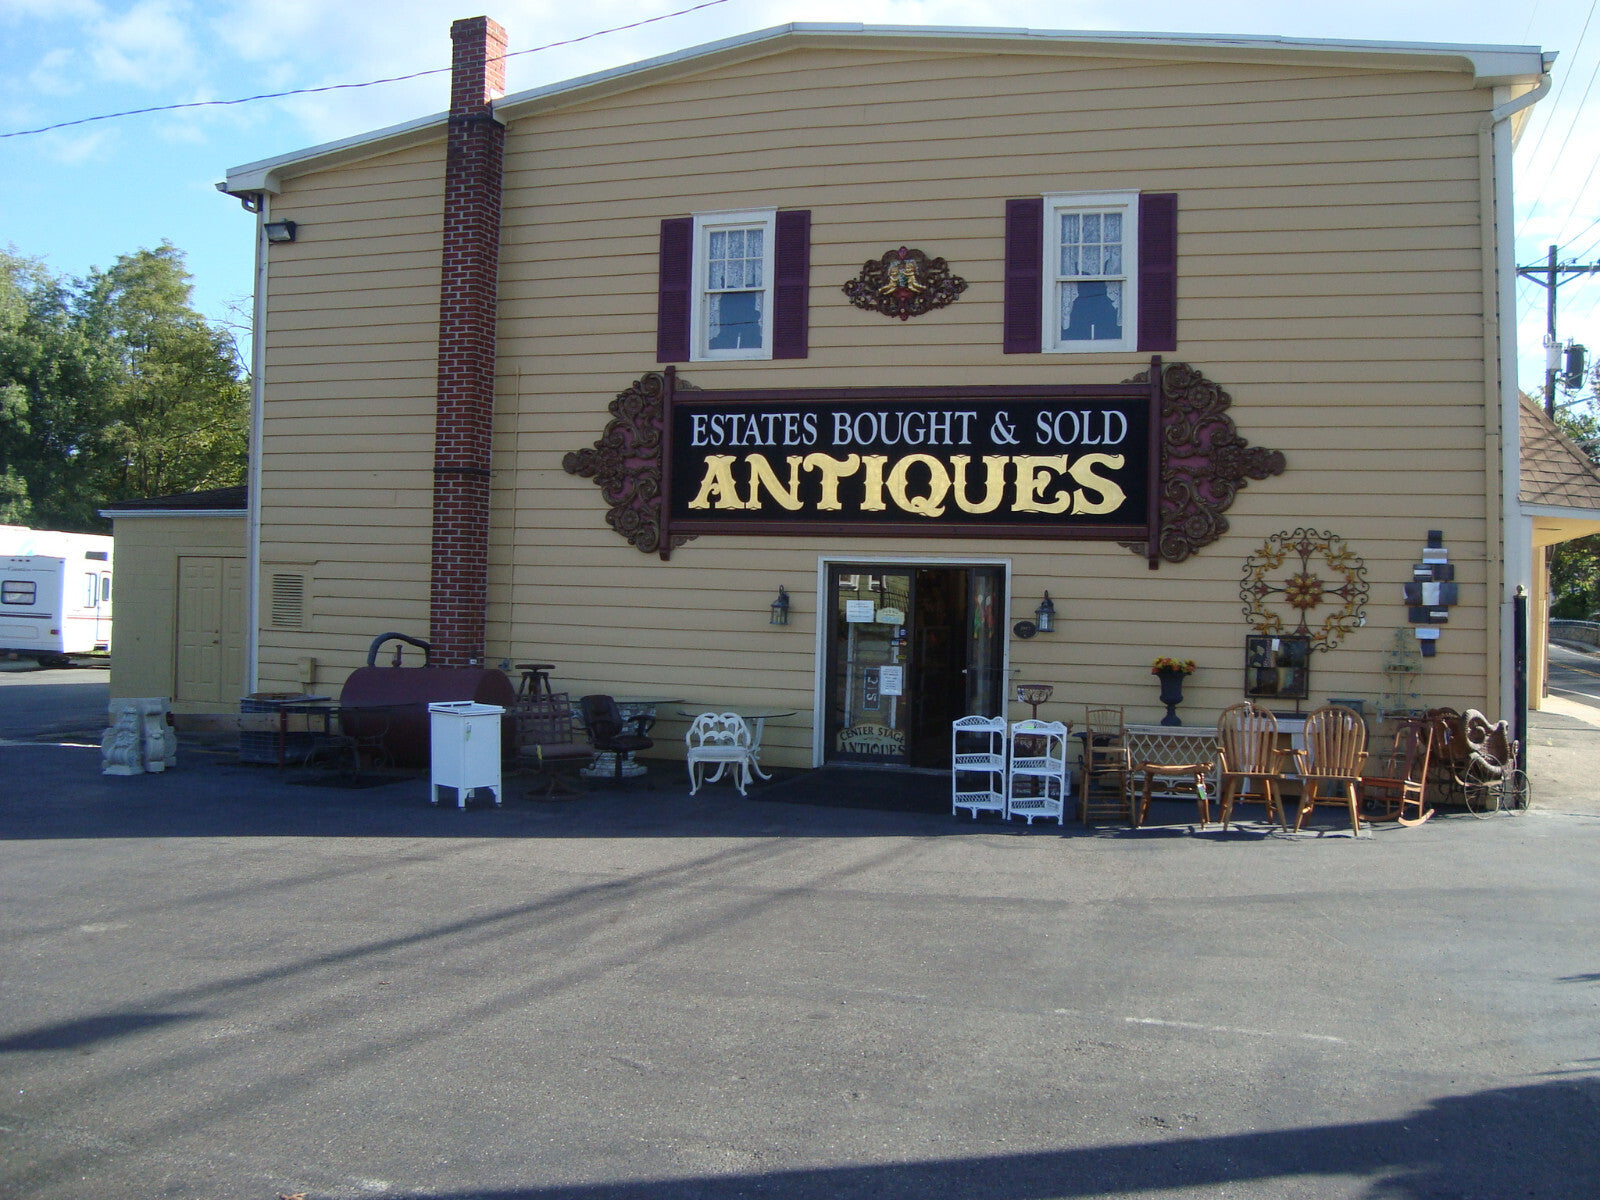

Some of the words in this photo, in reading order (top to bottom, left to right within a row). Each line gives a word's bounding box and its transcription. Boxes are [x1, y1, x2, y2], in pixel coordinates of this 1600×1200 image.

[691, 413, 818, 446] ESTATES
[832, 412, 976, 445] BOUGHT
[990, 411, 1020, 445] &
[1036, 411, 1129, 445] SOLD
[688, 453, 1127, 518] ANTIQUES
[840, 726, 874, 741] CENTER
